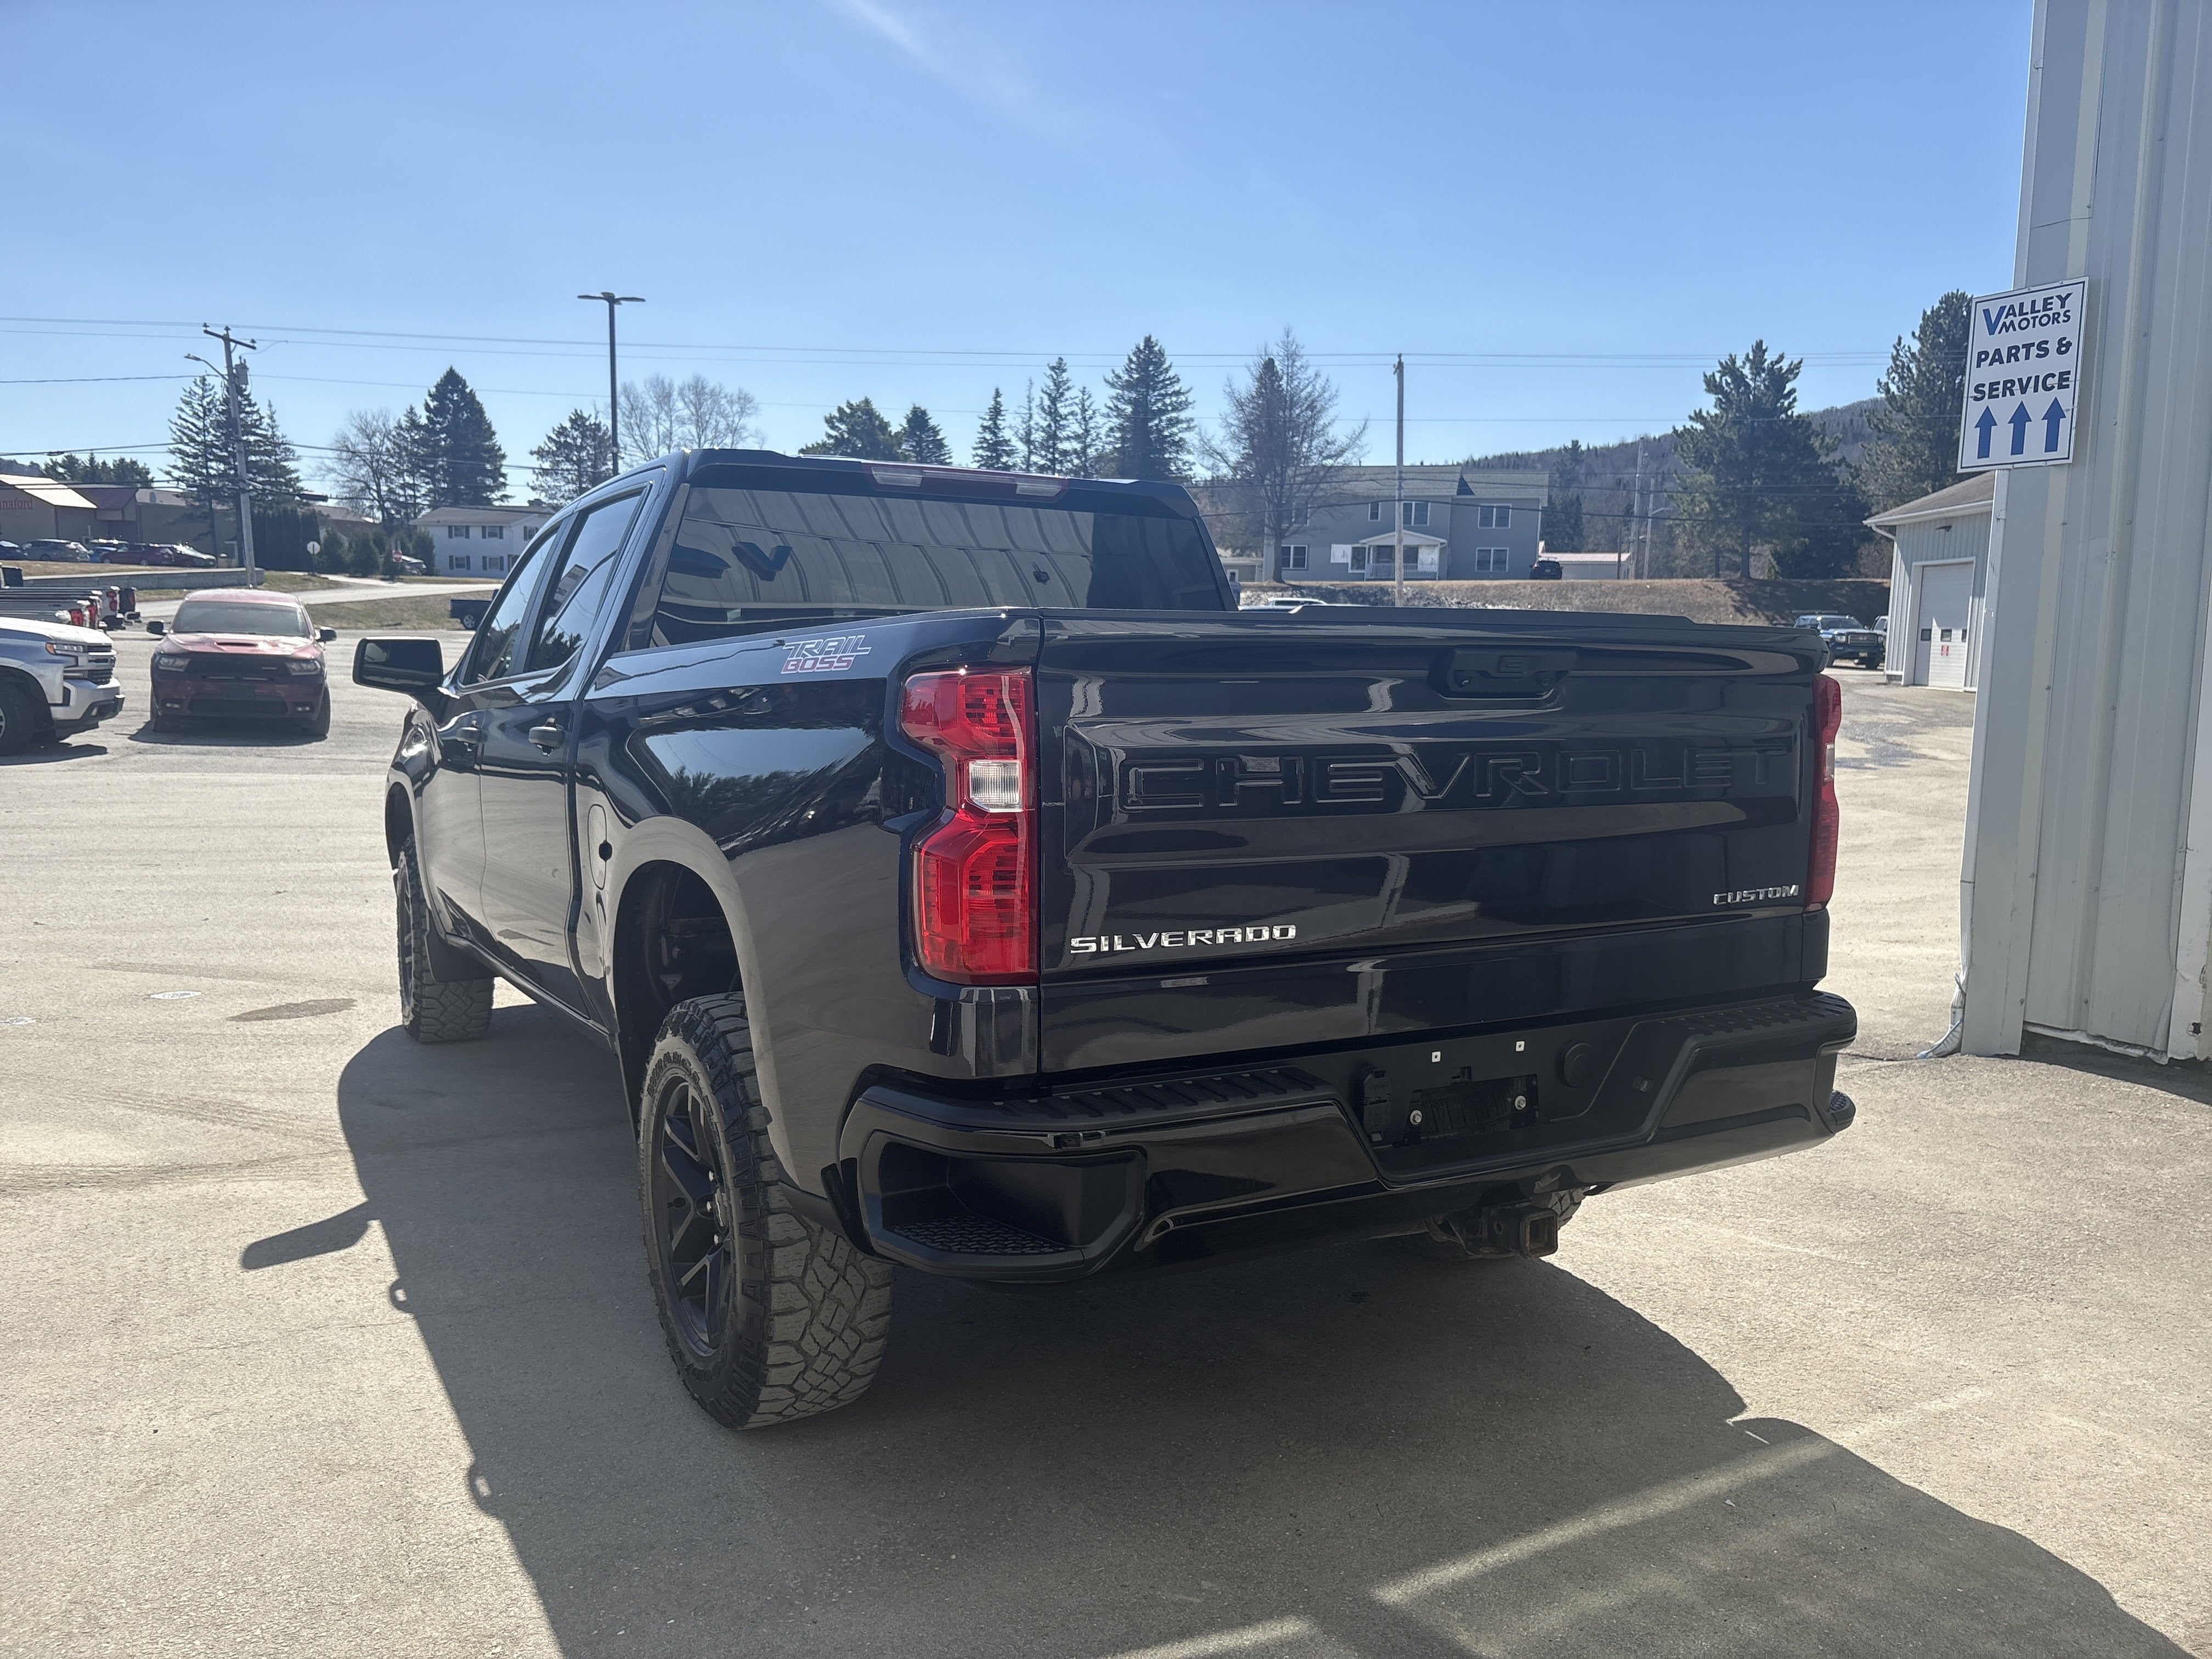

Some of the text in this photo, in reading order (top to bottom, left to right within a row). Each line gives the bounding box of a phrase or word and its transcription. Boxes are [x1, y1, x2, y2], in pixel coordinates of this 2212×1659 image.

[1982, 292, 2073, 336] VALLEY
[1997, 309, 2072, 335] MOTORS
[1976, 336, 2073, 369] PARTS &
[1972, 370, 2072, 402] SERVICE
[782, 634, 872, 658] TRAIL
[781, 654, 857, 674] BOSS
[1117, 742, 1787, 812] CHEVROLET
[1713, 884, 1799, 905] CUSTOM
[1069, 924, 1297, 953] SILVERADO
